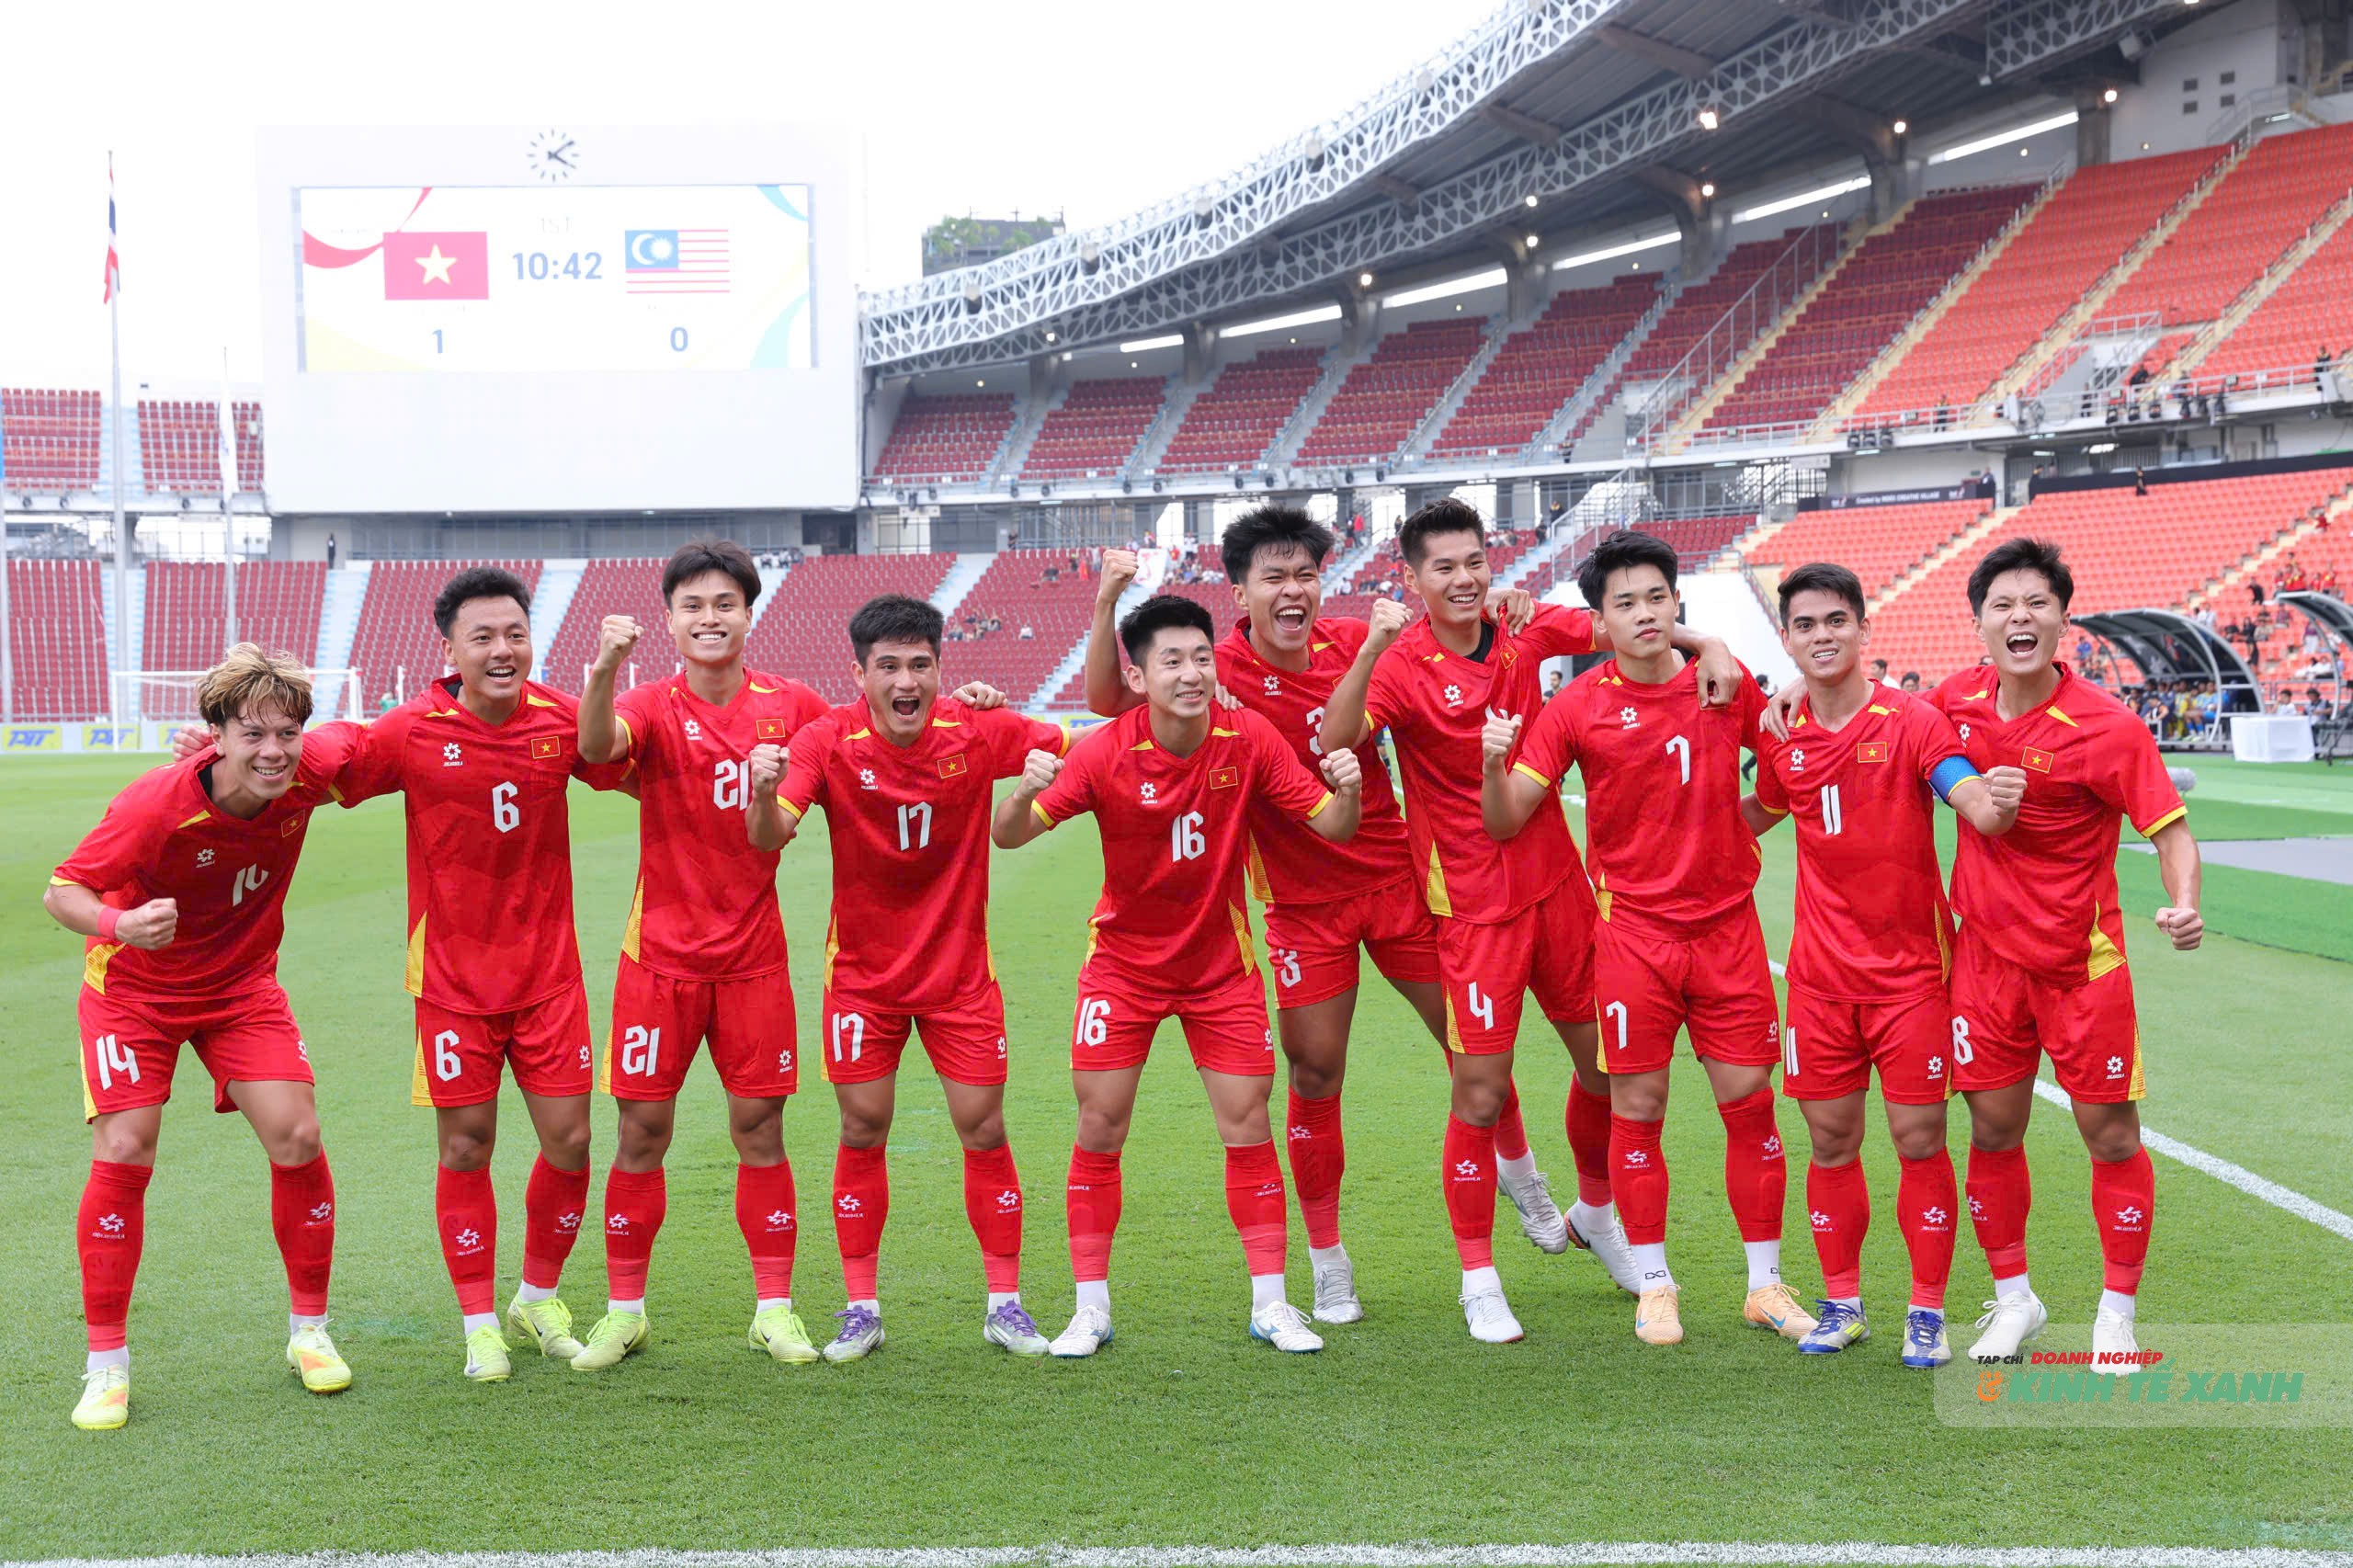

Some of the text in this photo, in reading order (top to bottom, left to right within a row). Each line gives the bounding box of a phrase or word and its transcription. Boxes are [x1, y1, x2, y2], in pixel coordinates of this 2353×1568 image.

[512, 251, 603, 280] 10:42
[432, 328, 443, 354] 1
[669, 326, 689, 353] 0
[713, 758, 750, 811] 21
[1665, 734, 1690, 786] 7
[492, 781, 520, 834] 6
[897, 801, 933, 851] 17
[1821, 783, 1842, 835] 11
[1171, 810, 1206, 863] 16
[1278, 949, 1302, 988] 3
[1075, 997, 1111, 1047] 16
[1468, 981, 1495, 1031] 4
[1606, 1000, 1628, 1050] 7
[95, 1033, 141, 1091] 14
[435, 1028, 461, 1082] 6
[621, 1024, 661, 1077] 21
[832, 1012, 865, 1062] 17
[1785, 1026, 1800, 1076] 11
[1951, 1015, 1974, 1066] 8
